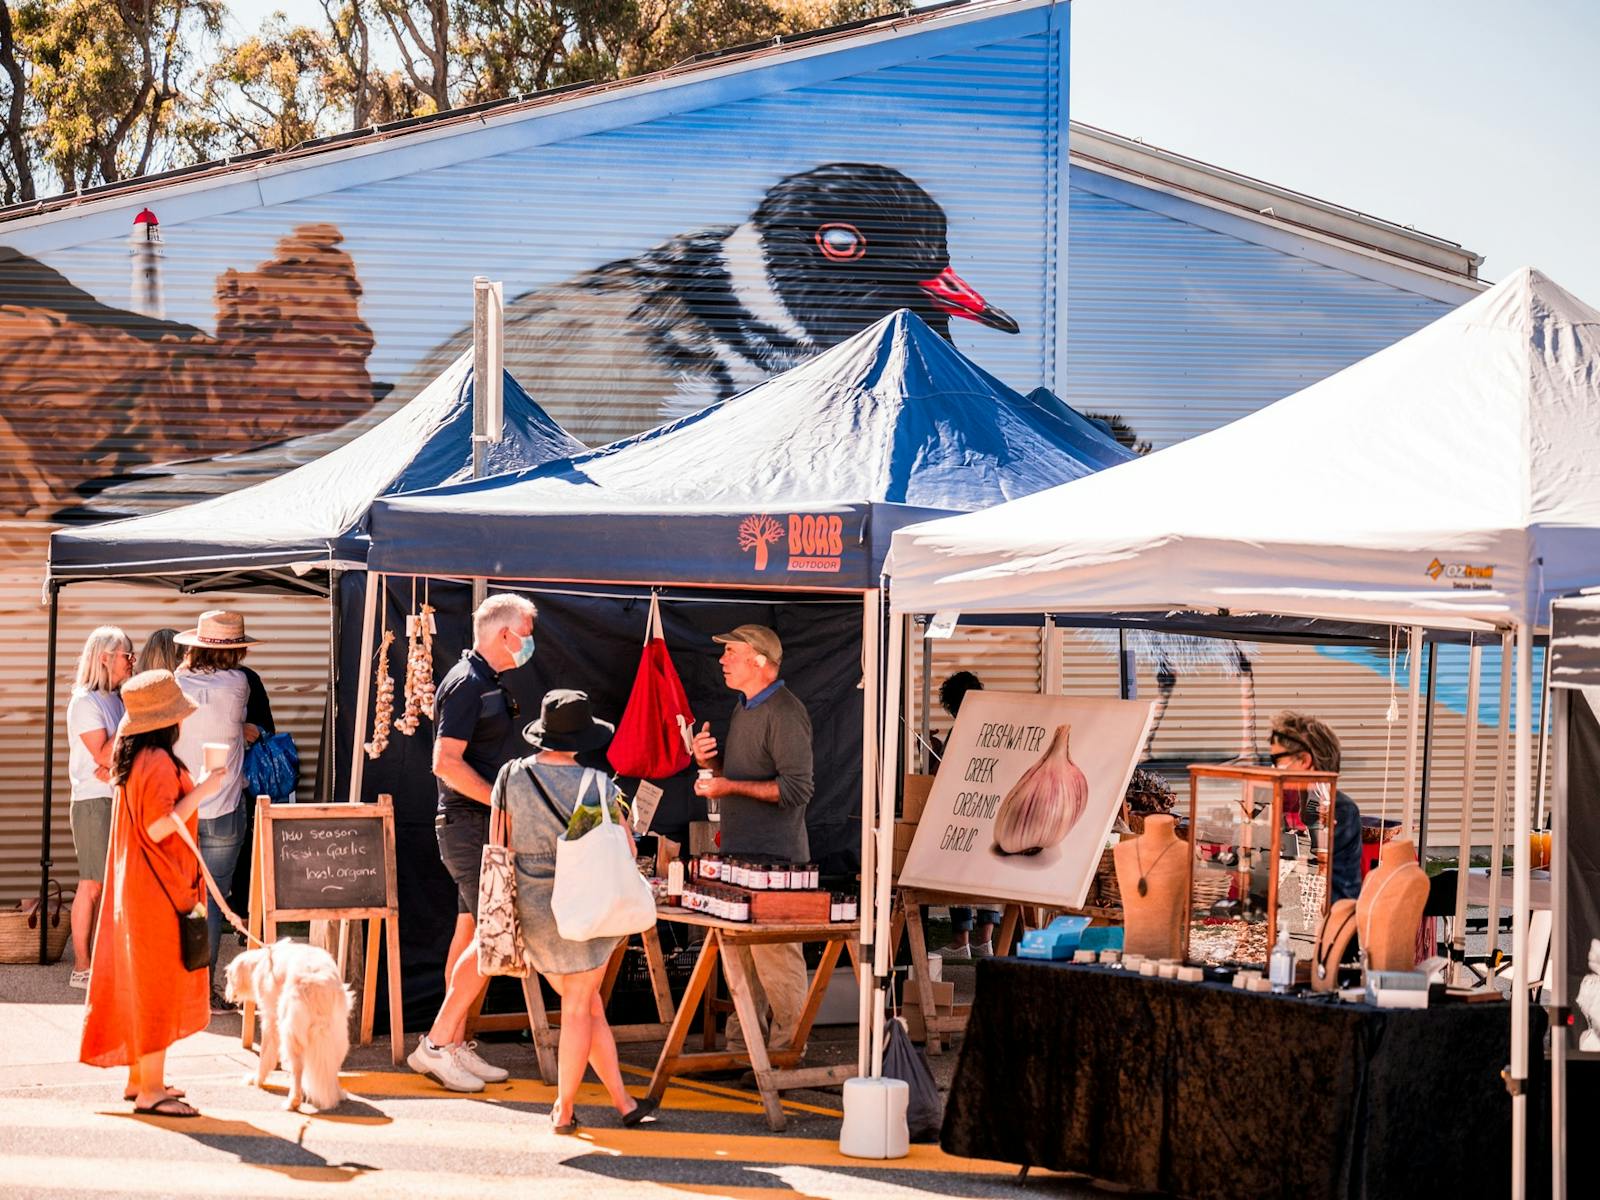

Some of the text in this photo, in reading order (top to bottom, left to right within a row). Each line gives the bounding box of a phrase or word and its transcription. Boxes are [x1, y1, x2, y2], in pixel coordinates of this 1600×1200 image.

[788, 514, 843, 556] BOAB
[791, 560, 837, 569] OUTDOOR
[975, 722, 1046, 752] FRESHWATER
[964, 757, 999, 784] CREEK
[952, 792, 1000, 820] ORGANIC
[310, 829, 358, 840] season
[939, 824, 978, 853] GARLIC
